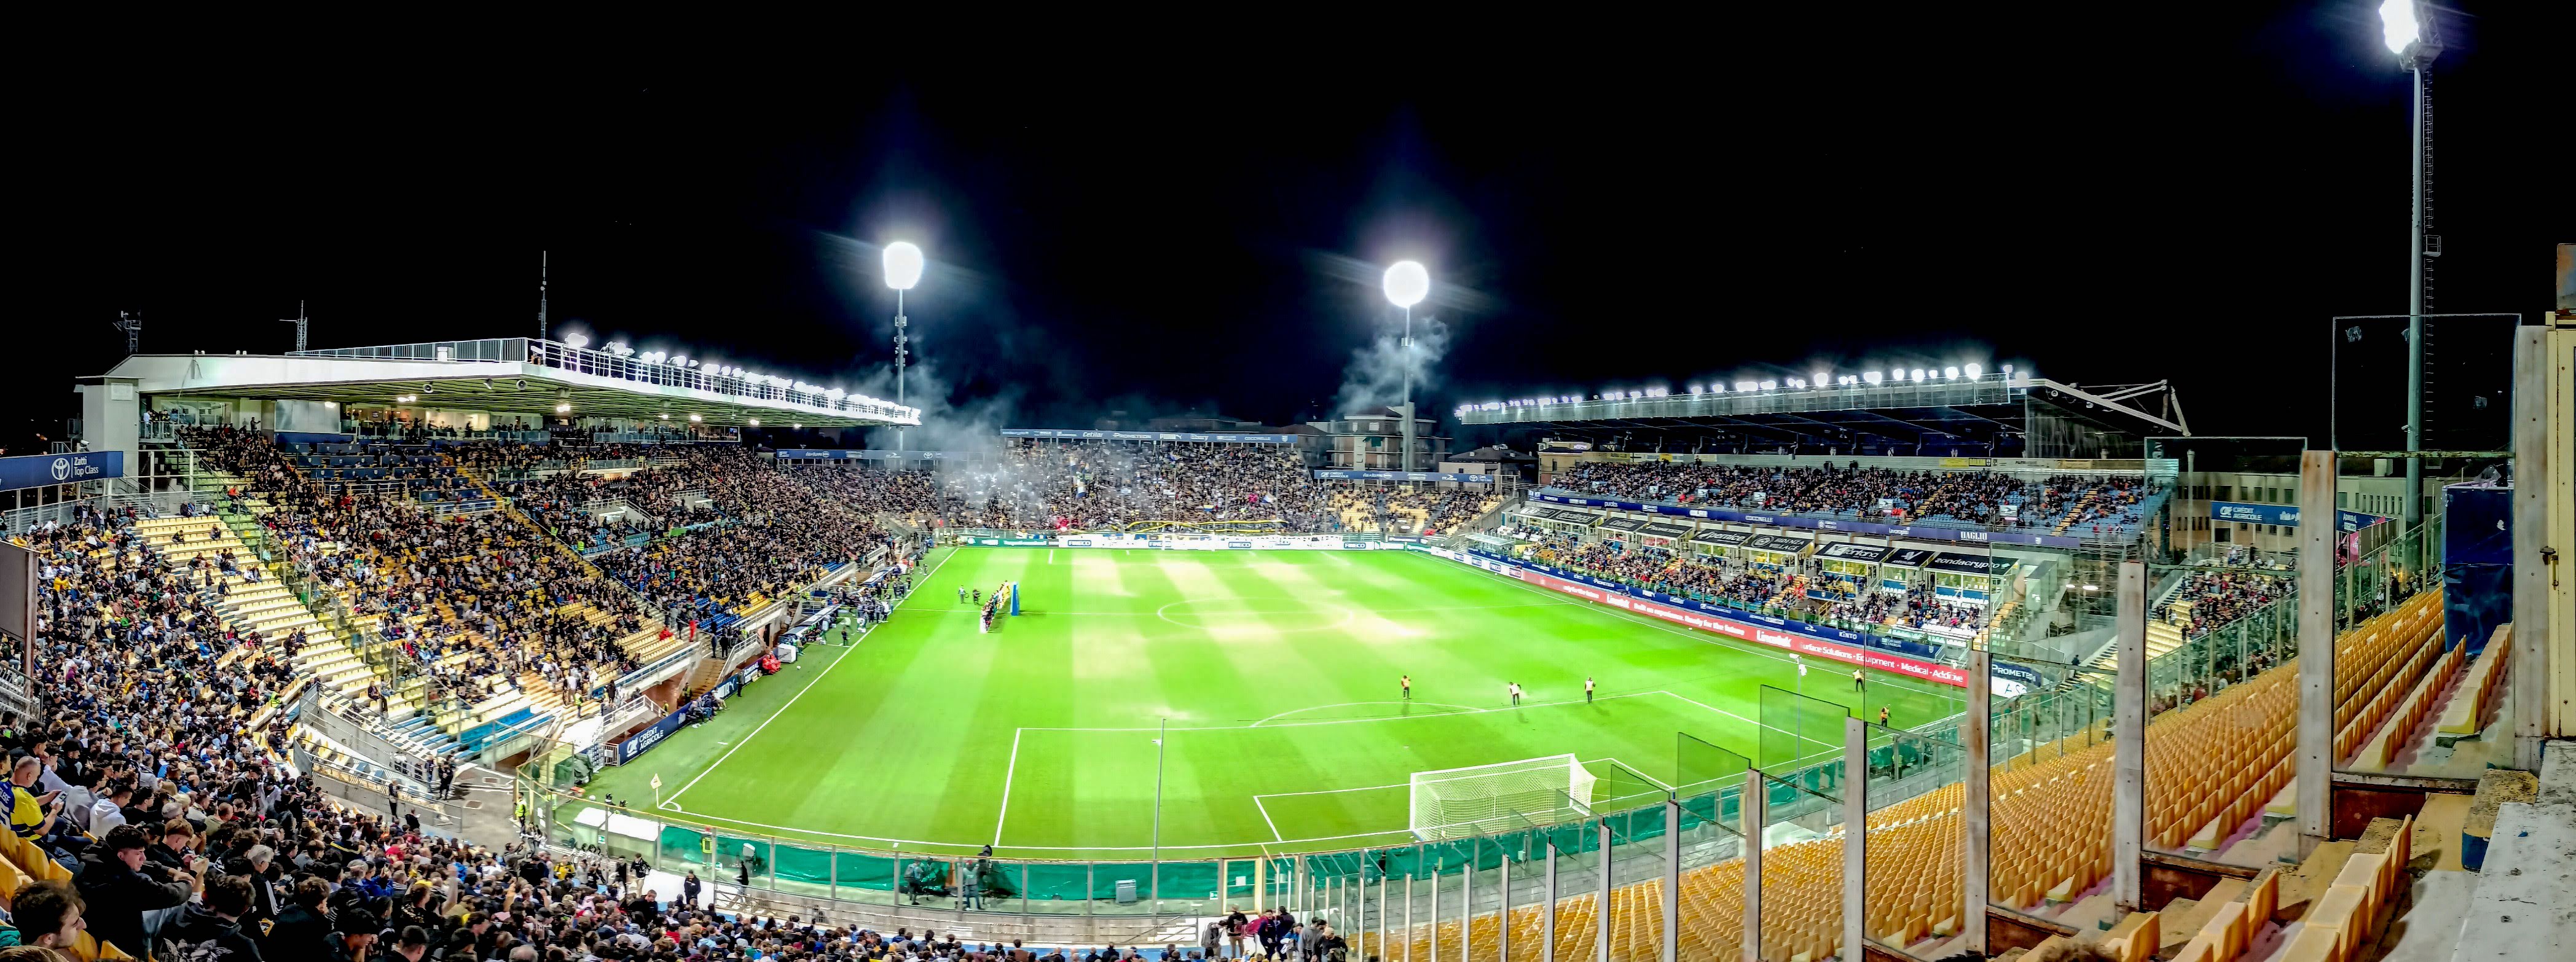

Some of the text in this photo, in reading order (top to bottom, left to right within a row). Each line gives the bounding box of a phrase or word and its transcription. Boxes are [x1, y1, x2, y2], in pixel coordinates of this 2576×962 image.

[74, 456, 87, 466] Zatti
[74, 465, 99, 477] Top Class
[1823, 645, 1852, 659] Solutions
[1901, 662, 1928, 675] Medical
[639, 726, 658, 742] CRÉDIT
[639, 730, 664, 751] AGRICOLE
